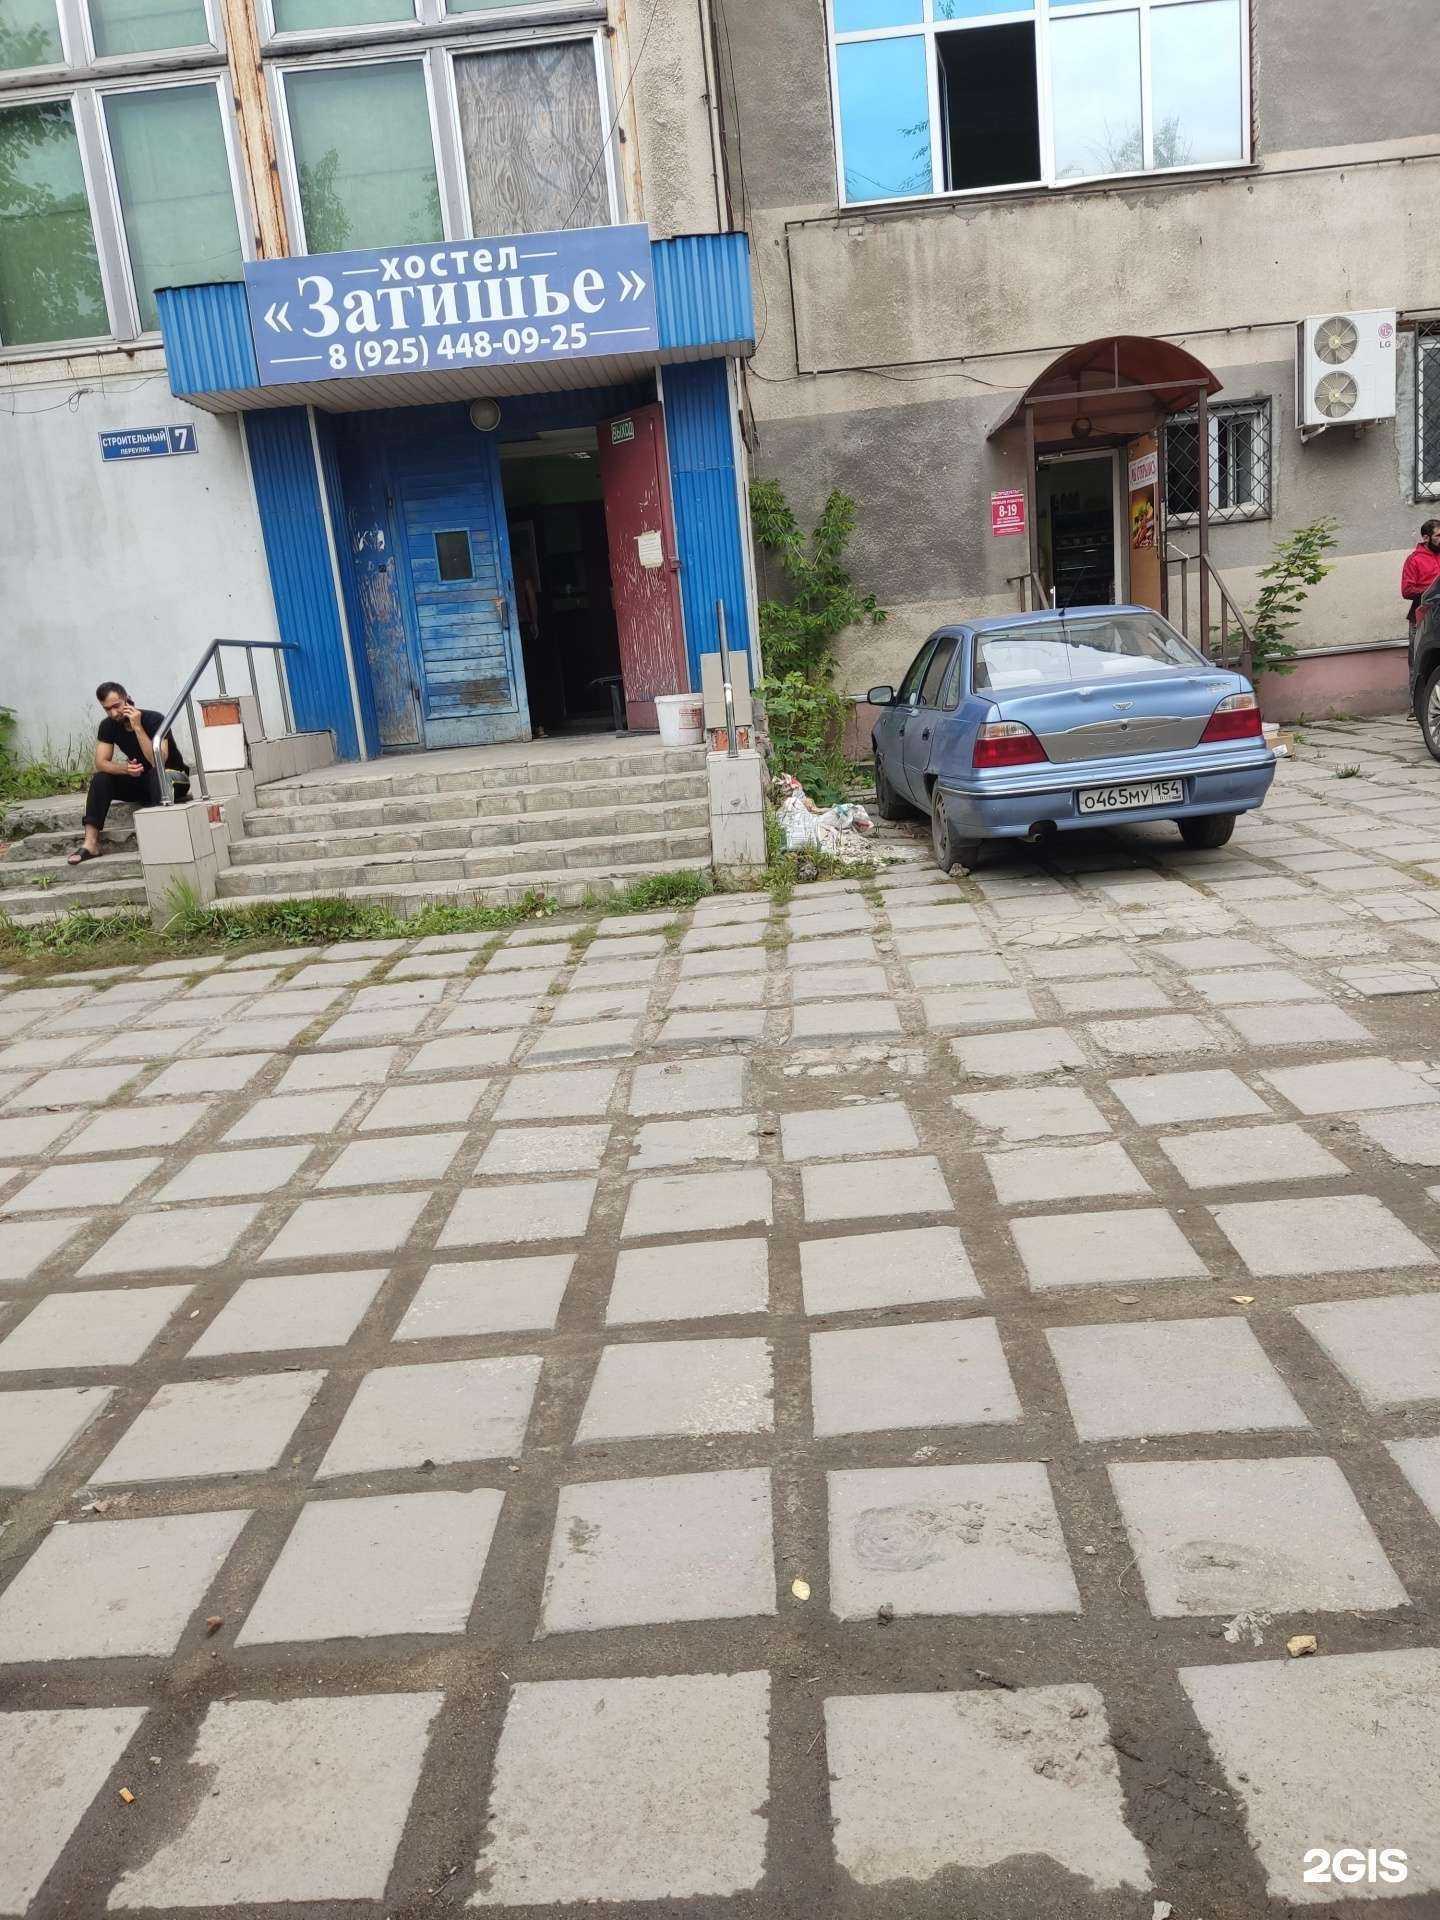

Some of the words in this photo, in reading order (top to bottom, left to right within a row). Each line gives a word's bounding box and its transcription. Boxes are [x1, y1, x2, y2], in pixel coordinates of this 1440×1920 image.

[380, 246, 519, 281] хостел
[328, 343, 348, 370] 8
[354, 335, 429, 371] (925)
[437, 322, 588, 360] 448-09-25
[1379, 341, 1391, 349] LG
[102, 430, 167, 447] СТРОИТЕЛЬНЫЙ
[174, 428, 187, 450] 7
[120, 446, 151, 455] ПЕРЕУЛОК
[999, 504, 1017, 517] 8-19
[1084, 788, 1149, 809] О465МУ
[1154, 781, 1179, 796] 154
